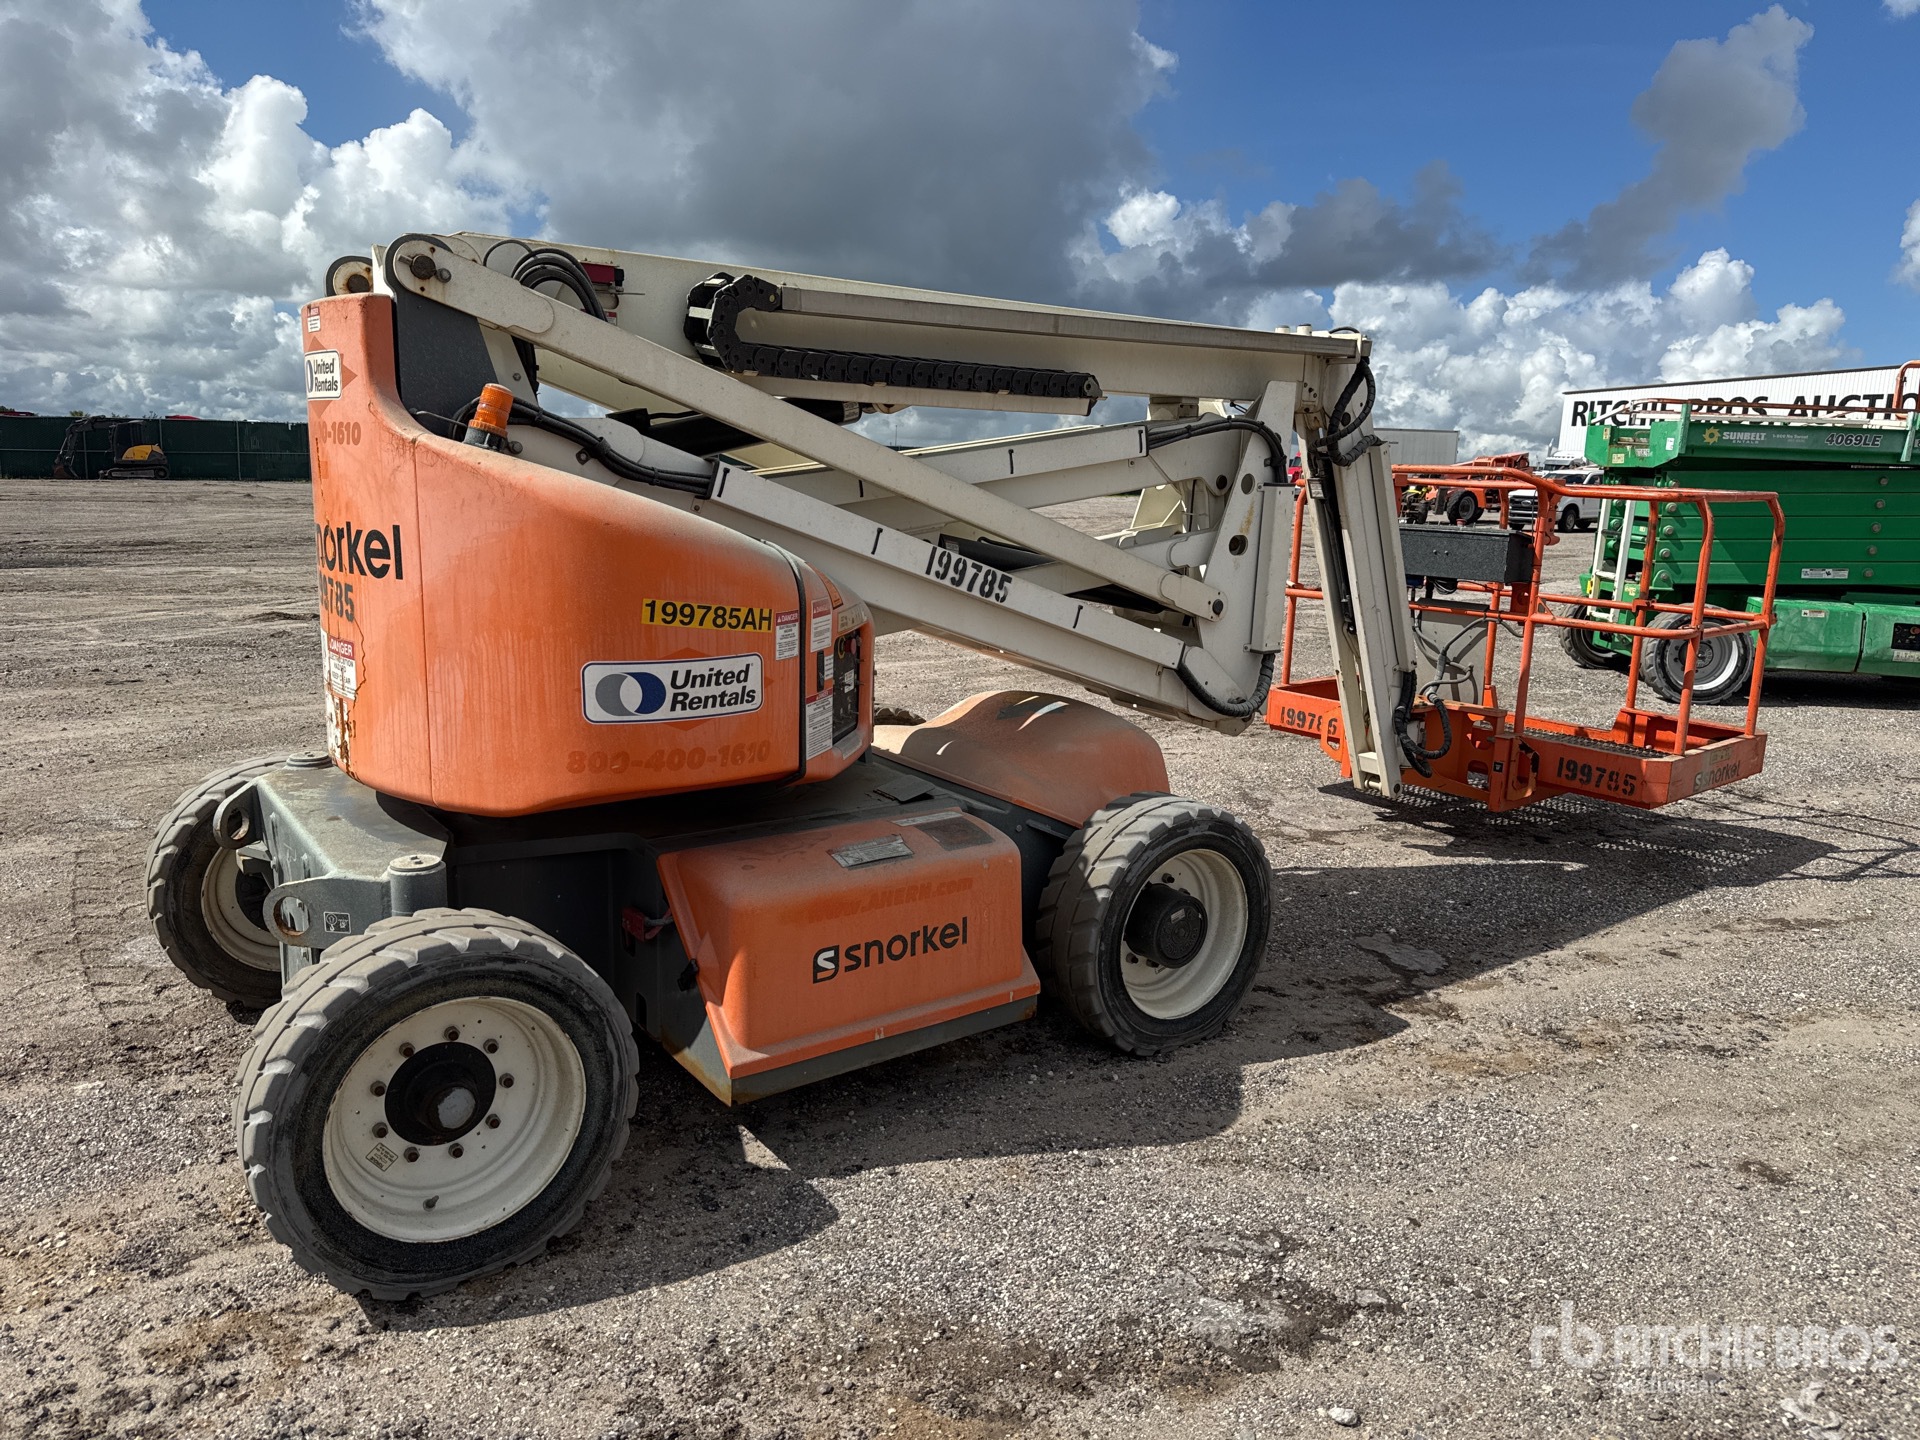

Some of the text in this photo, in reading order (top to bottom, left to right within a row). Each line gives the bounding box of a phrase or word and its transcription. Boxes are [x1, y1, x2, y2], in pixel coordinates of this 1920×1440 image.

[313, 358, 335, 375] United
[314, 376, 339, 391] Rentals
[1723, 431, 1766, 441] SUNBELT
[1825, 432, 1883, 447] 4069LE
[925, 546, 1013, 603] 199785
[645, 600, 773, 630] 199785AH
[329, 638, 353, 657] DANGER
[670, 663, 751, 690] United
[670, 685, 757, 712] Rentals
[566, 740, 771, 774] 800-400-1610
[1557, 757, 1637, 797] 199785
[844, 917, 968, 972] snorkel
